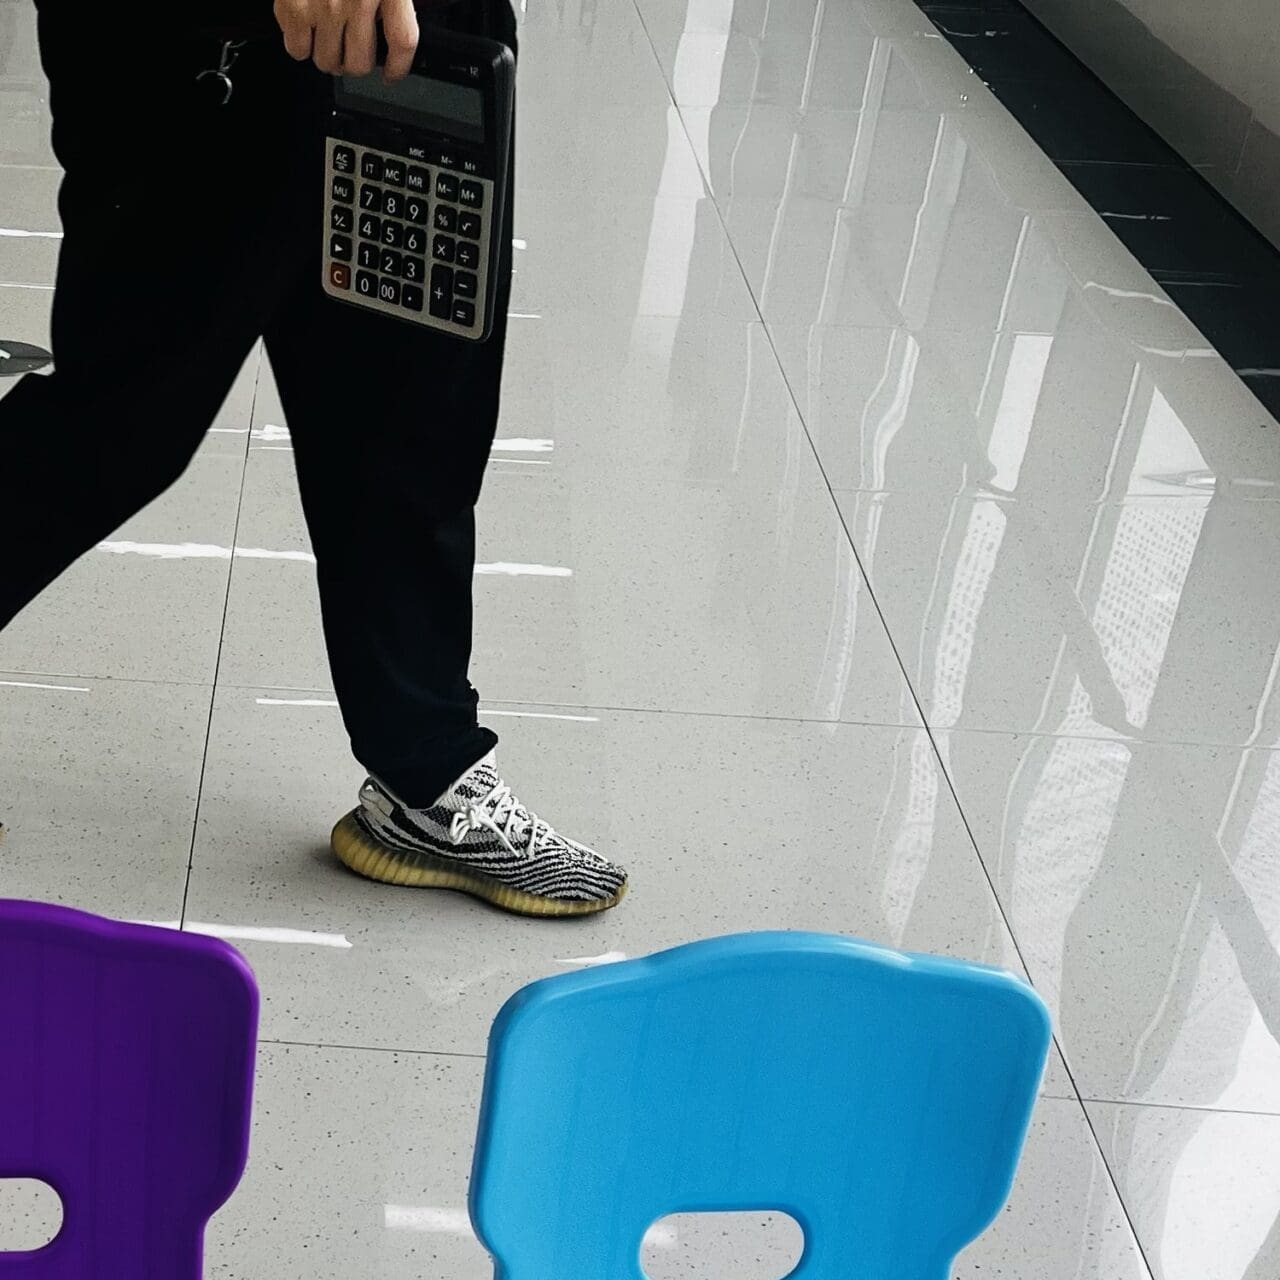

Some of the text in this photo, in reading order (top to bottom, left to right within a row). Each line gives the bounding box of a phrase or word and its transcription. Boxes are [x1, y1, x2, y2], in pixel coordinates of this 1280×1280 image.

[386, 169, 399, 181] MC
[409, 175, 422, 187] MR
[335, 185, 347, 197] MU
[366, 191, 373, 206] 7
[387, 198, 395, 213] 8
[410, 205, 418, 219] 9
[363, 222, 371, 235] 4
[386, 227, 394, 242] 5
[409, 235, 416, 249] 6
[385, 257, 392, 271] 2
[407, 263, 415, 277] 3
[334, 271, 342, 283] C
[361, 278, 368, 292] 0
[381, 285, 395, 300] 00
